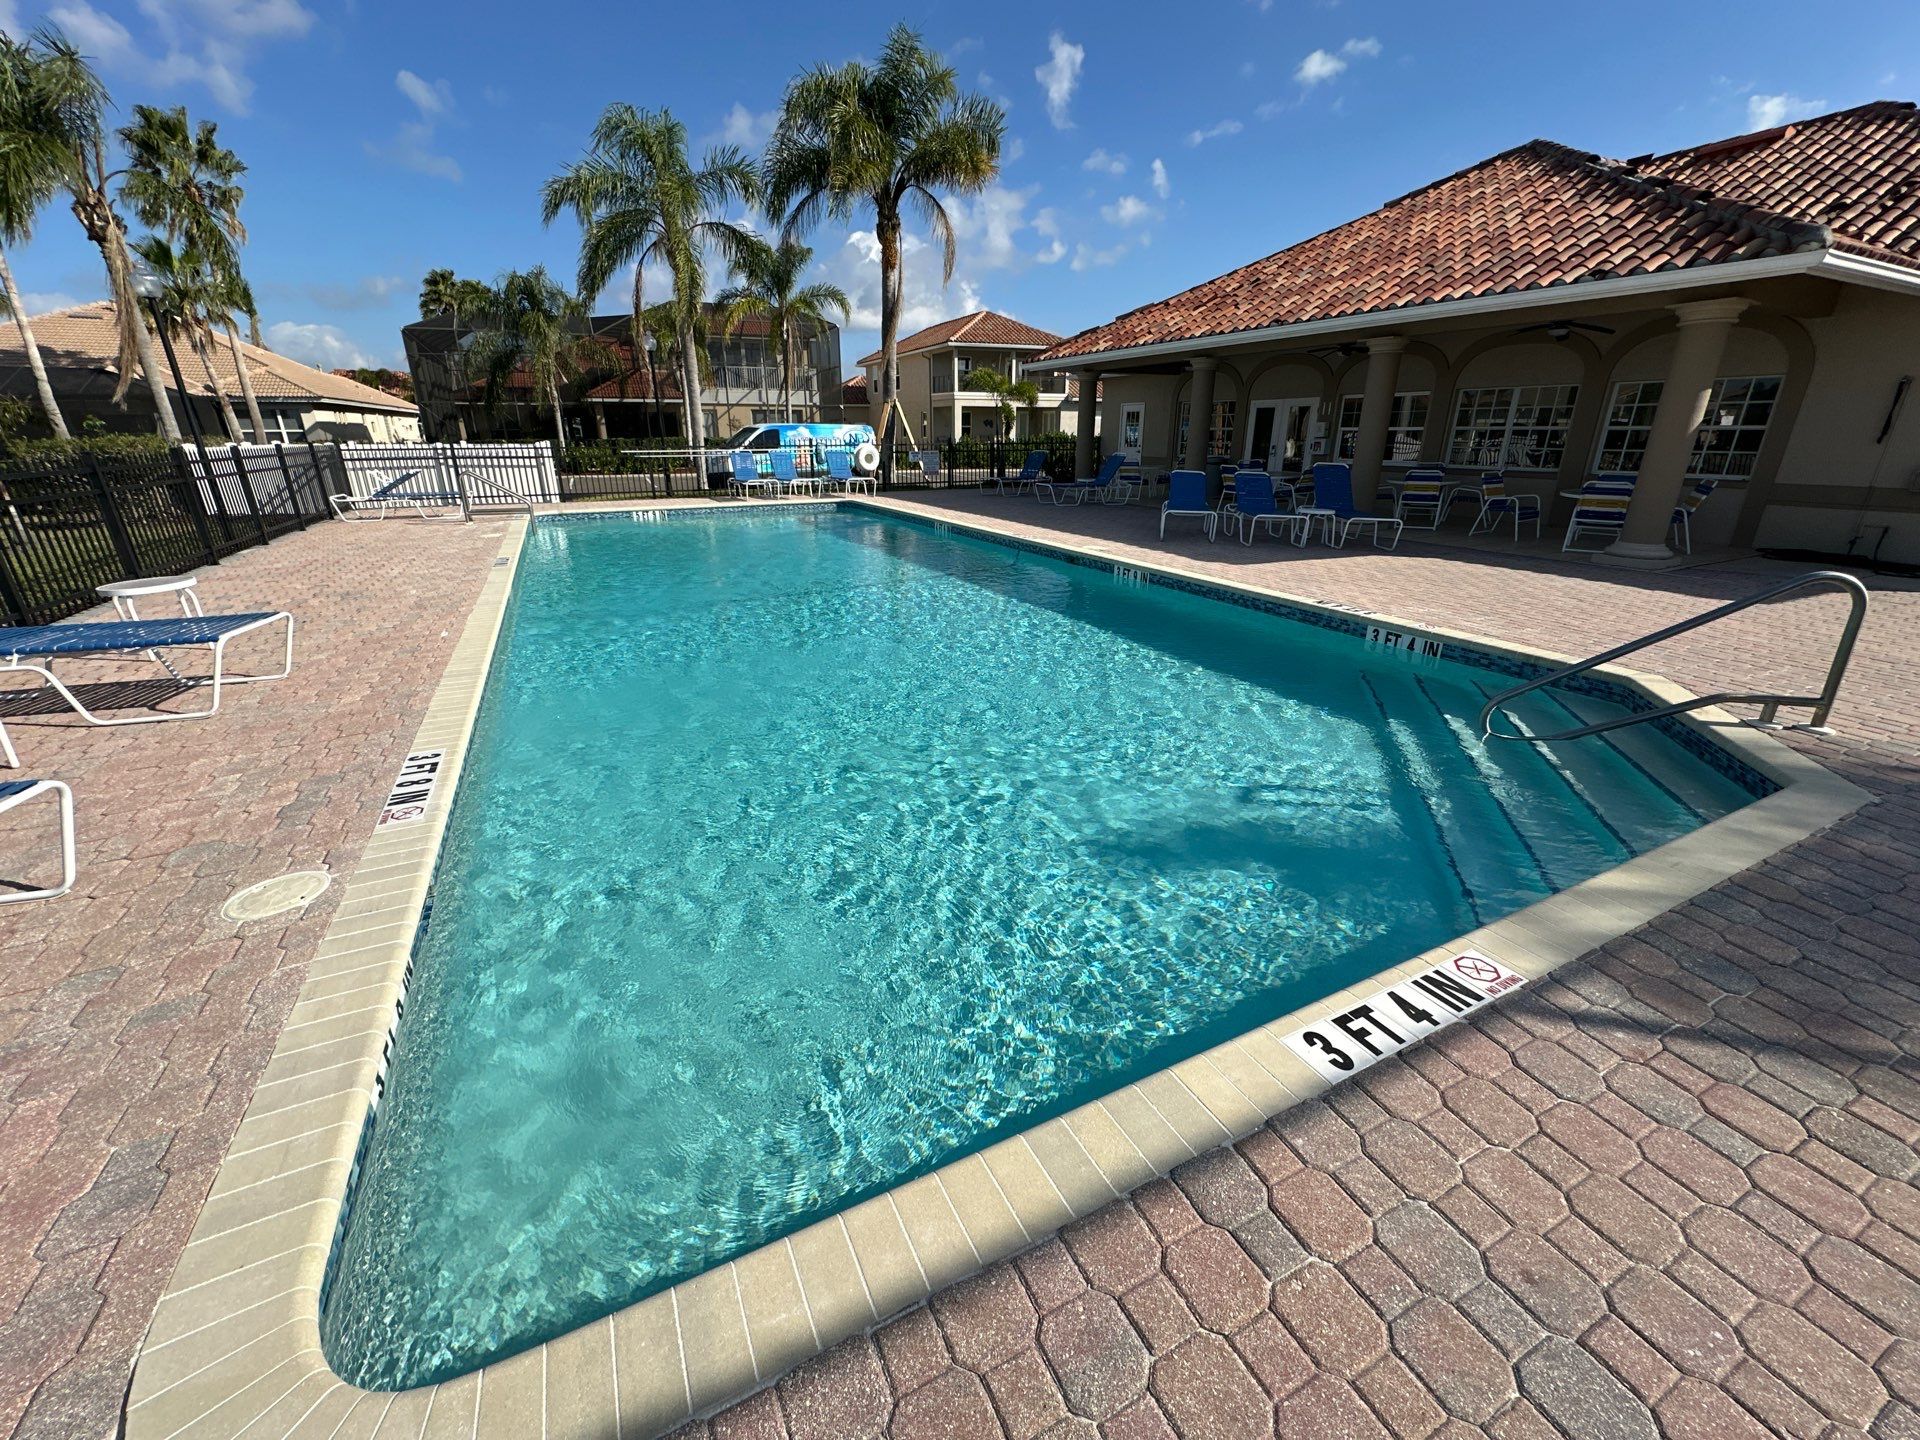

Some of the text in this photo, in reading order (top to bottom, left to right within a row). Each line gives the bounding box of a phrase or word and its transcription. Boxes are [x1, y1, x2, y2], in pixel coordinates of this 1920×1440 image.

[1116, 566, 1121, 575] 3
[1123, 568, 1131, 579] FT
[1140, 571, 1148, 583] IN
[1371, 628, 1440, 657] 3 FT 4 IN
[387, 753, 442, 807] 3 FT 8 IN
[1485, 974, 1524, 996] NO DIVING
[1302, 969, 1485, 1071] 3 FT 4 IN
